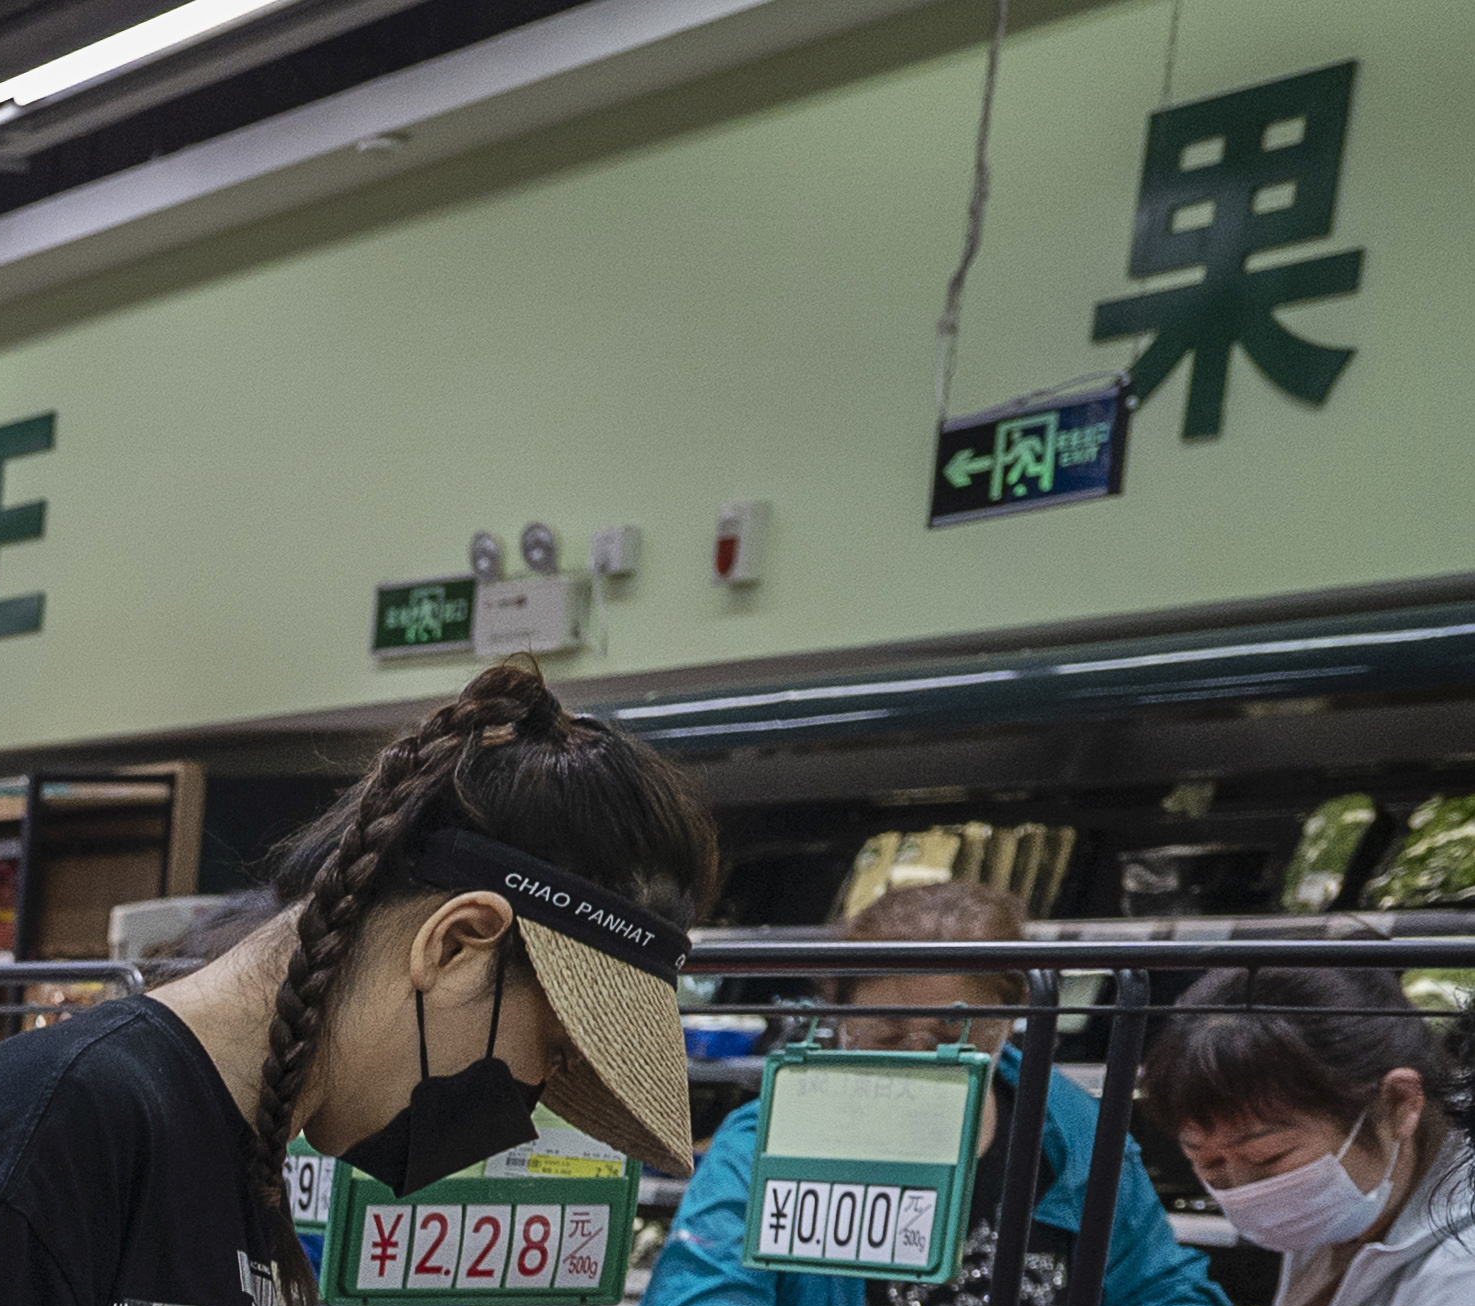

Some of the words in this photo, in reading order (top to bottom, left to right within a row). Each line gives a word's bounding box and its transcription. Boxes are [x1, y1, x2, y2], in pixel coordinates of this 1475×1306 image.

[1091, 59, 1365, 440] 果
[504, 873, 570, 907] CHAO
[575, 901, 655, 947] PANHAT
[369, 1212, 552, 1279] ¥2.28
[768, 1187, 892, 1249] ¥0.00
